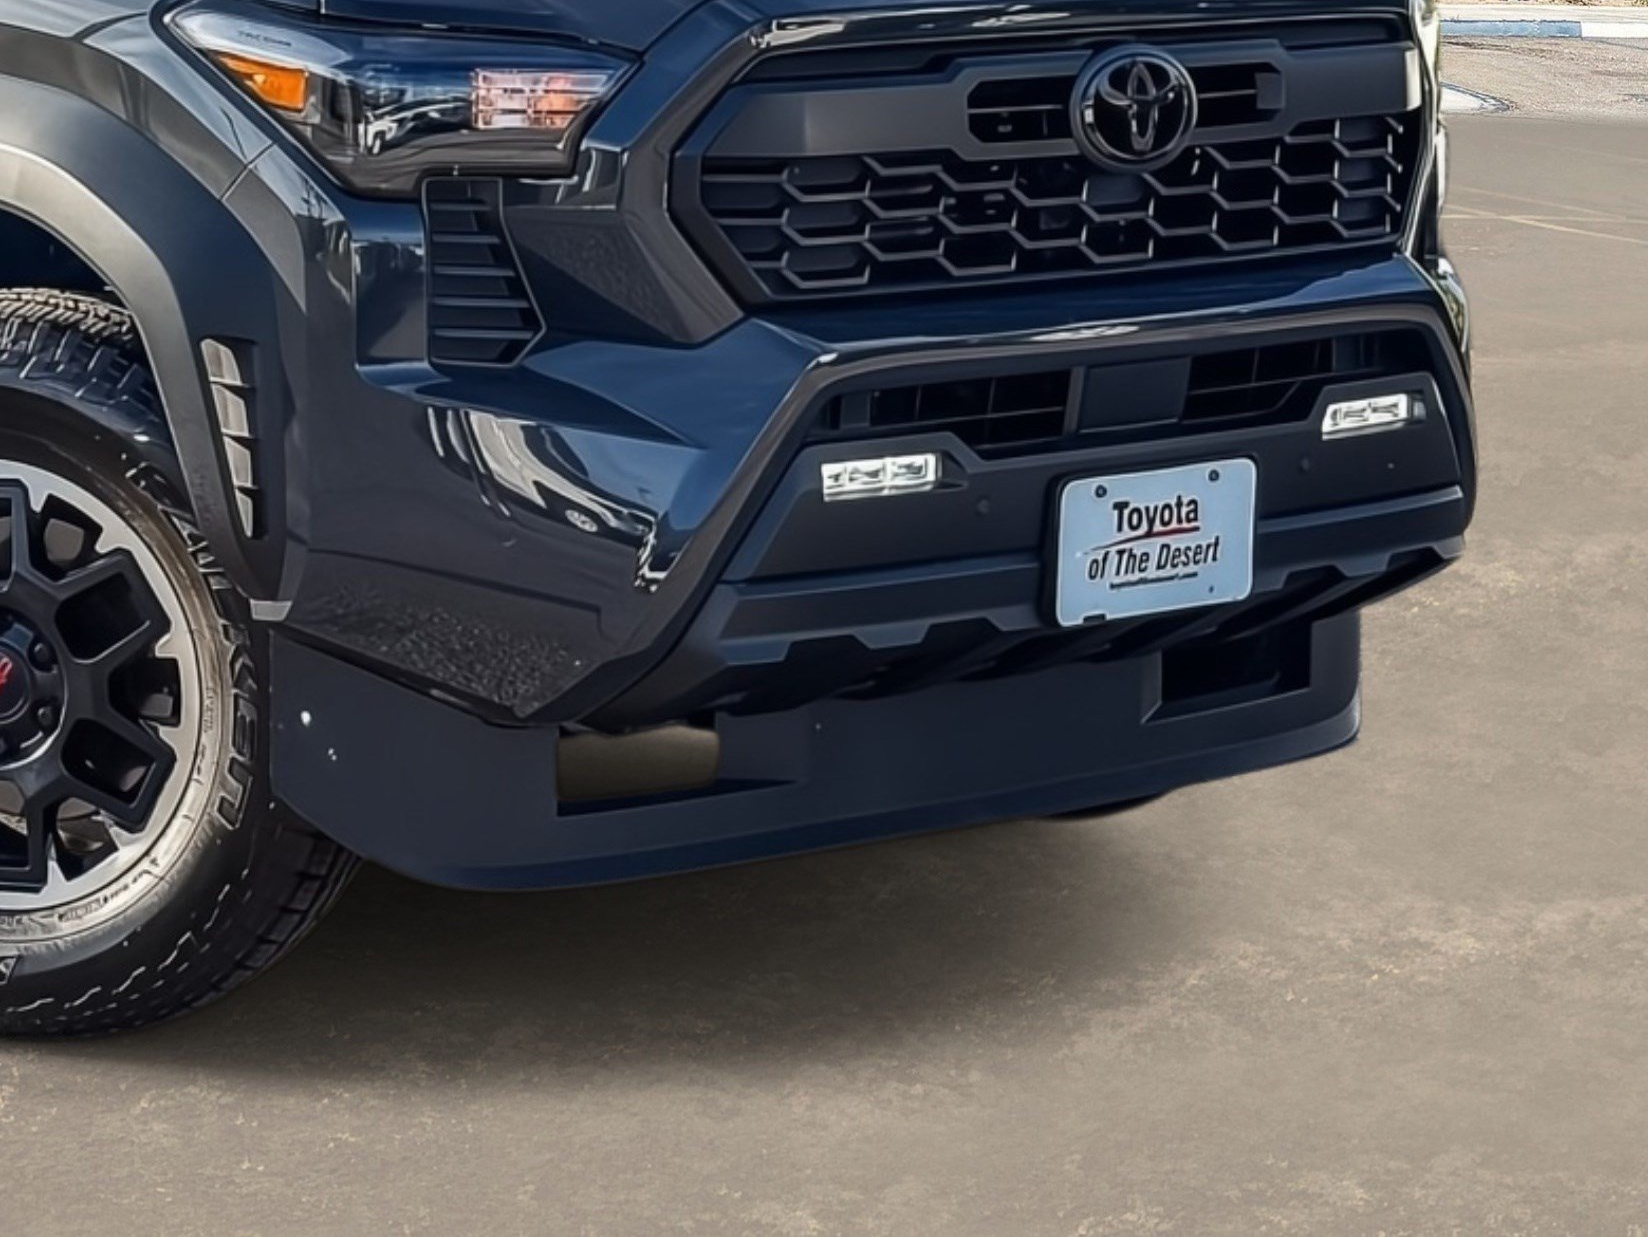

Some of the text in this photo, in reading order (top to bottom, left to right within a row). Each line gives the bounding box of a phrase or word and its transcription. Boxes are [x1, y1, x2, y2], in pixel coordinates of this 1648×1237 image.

[1112, 495, 1199, 536] Toyota
[1088, 551, 1110, 581] of
[1115, 547, 1150, 577] The
[1156, 535, 1220, 570] Desert
